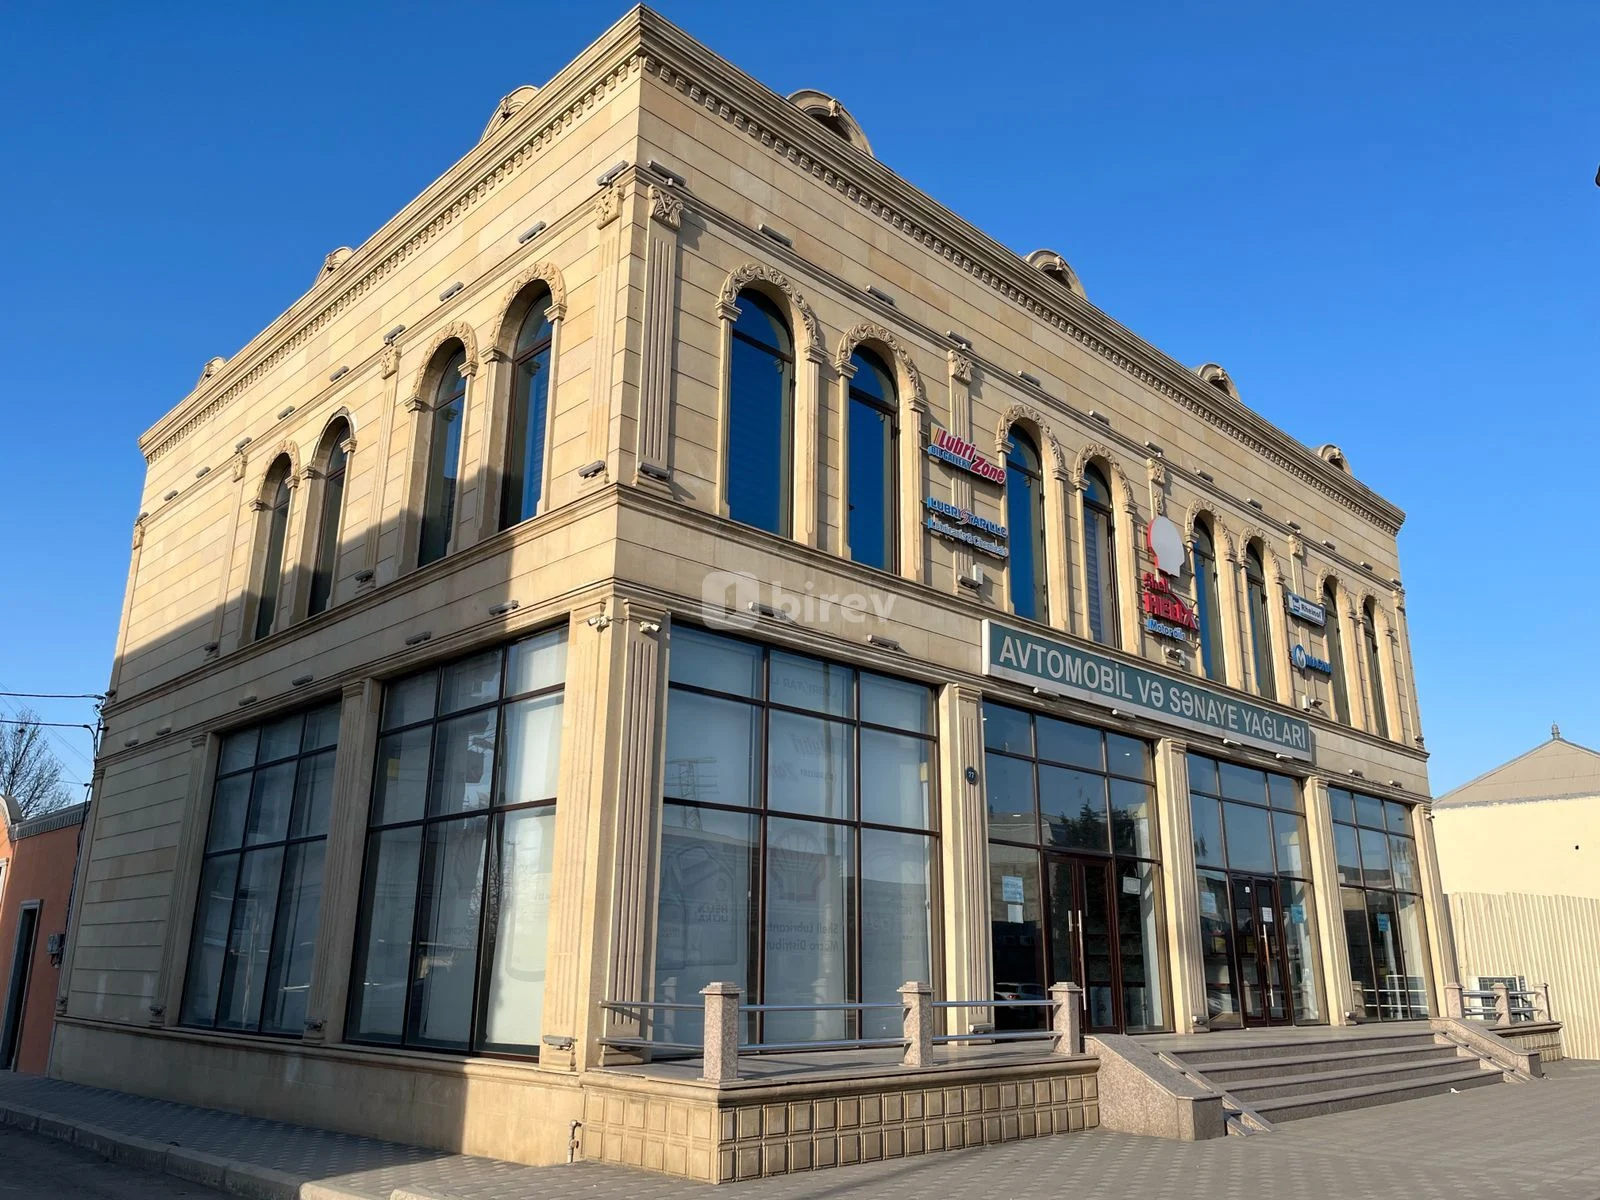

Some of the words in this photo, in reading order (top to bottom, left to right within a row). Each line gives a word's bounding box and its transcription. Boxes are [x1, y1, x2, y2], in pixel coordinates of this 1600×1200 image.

[939, 430, 976, 461] Lubri
[970, 455, 1006, 484] Zone
[989, 520, 1008, 537] LLC
[1149, 619, 1172, 637] Motor
[999, 636, 1133, 699] AVTOMOBİL
[1137, 676, 1164, 708] VƏ
[1169, 686, 1238, 729] SƏNAYE
[1244, 709, 1306, 749] YAĞLARI
